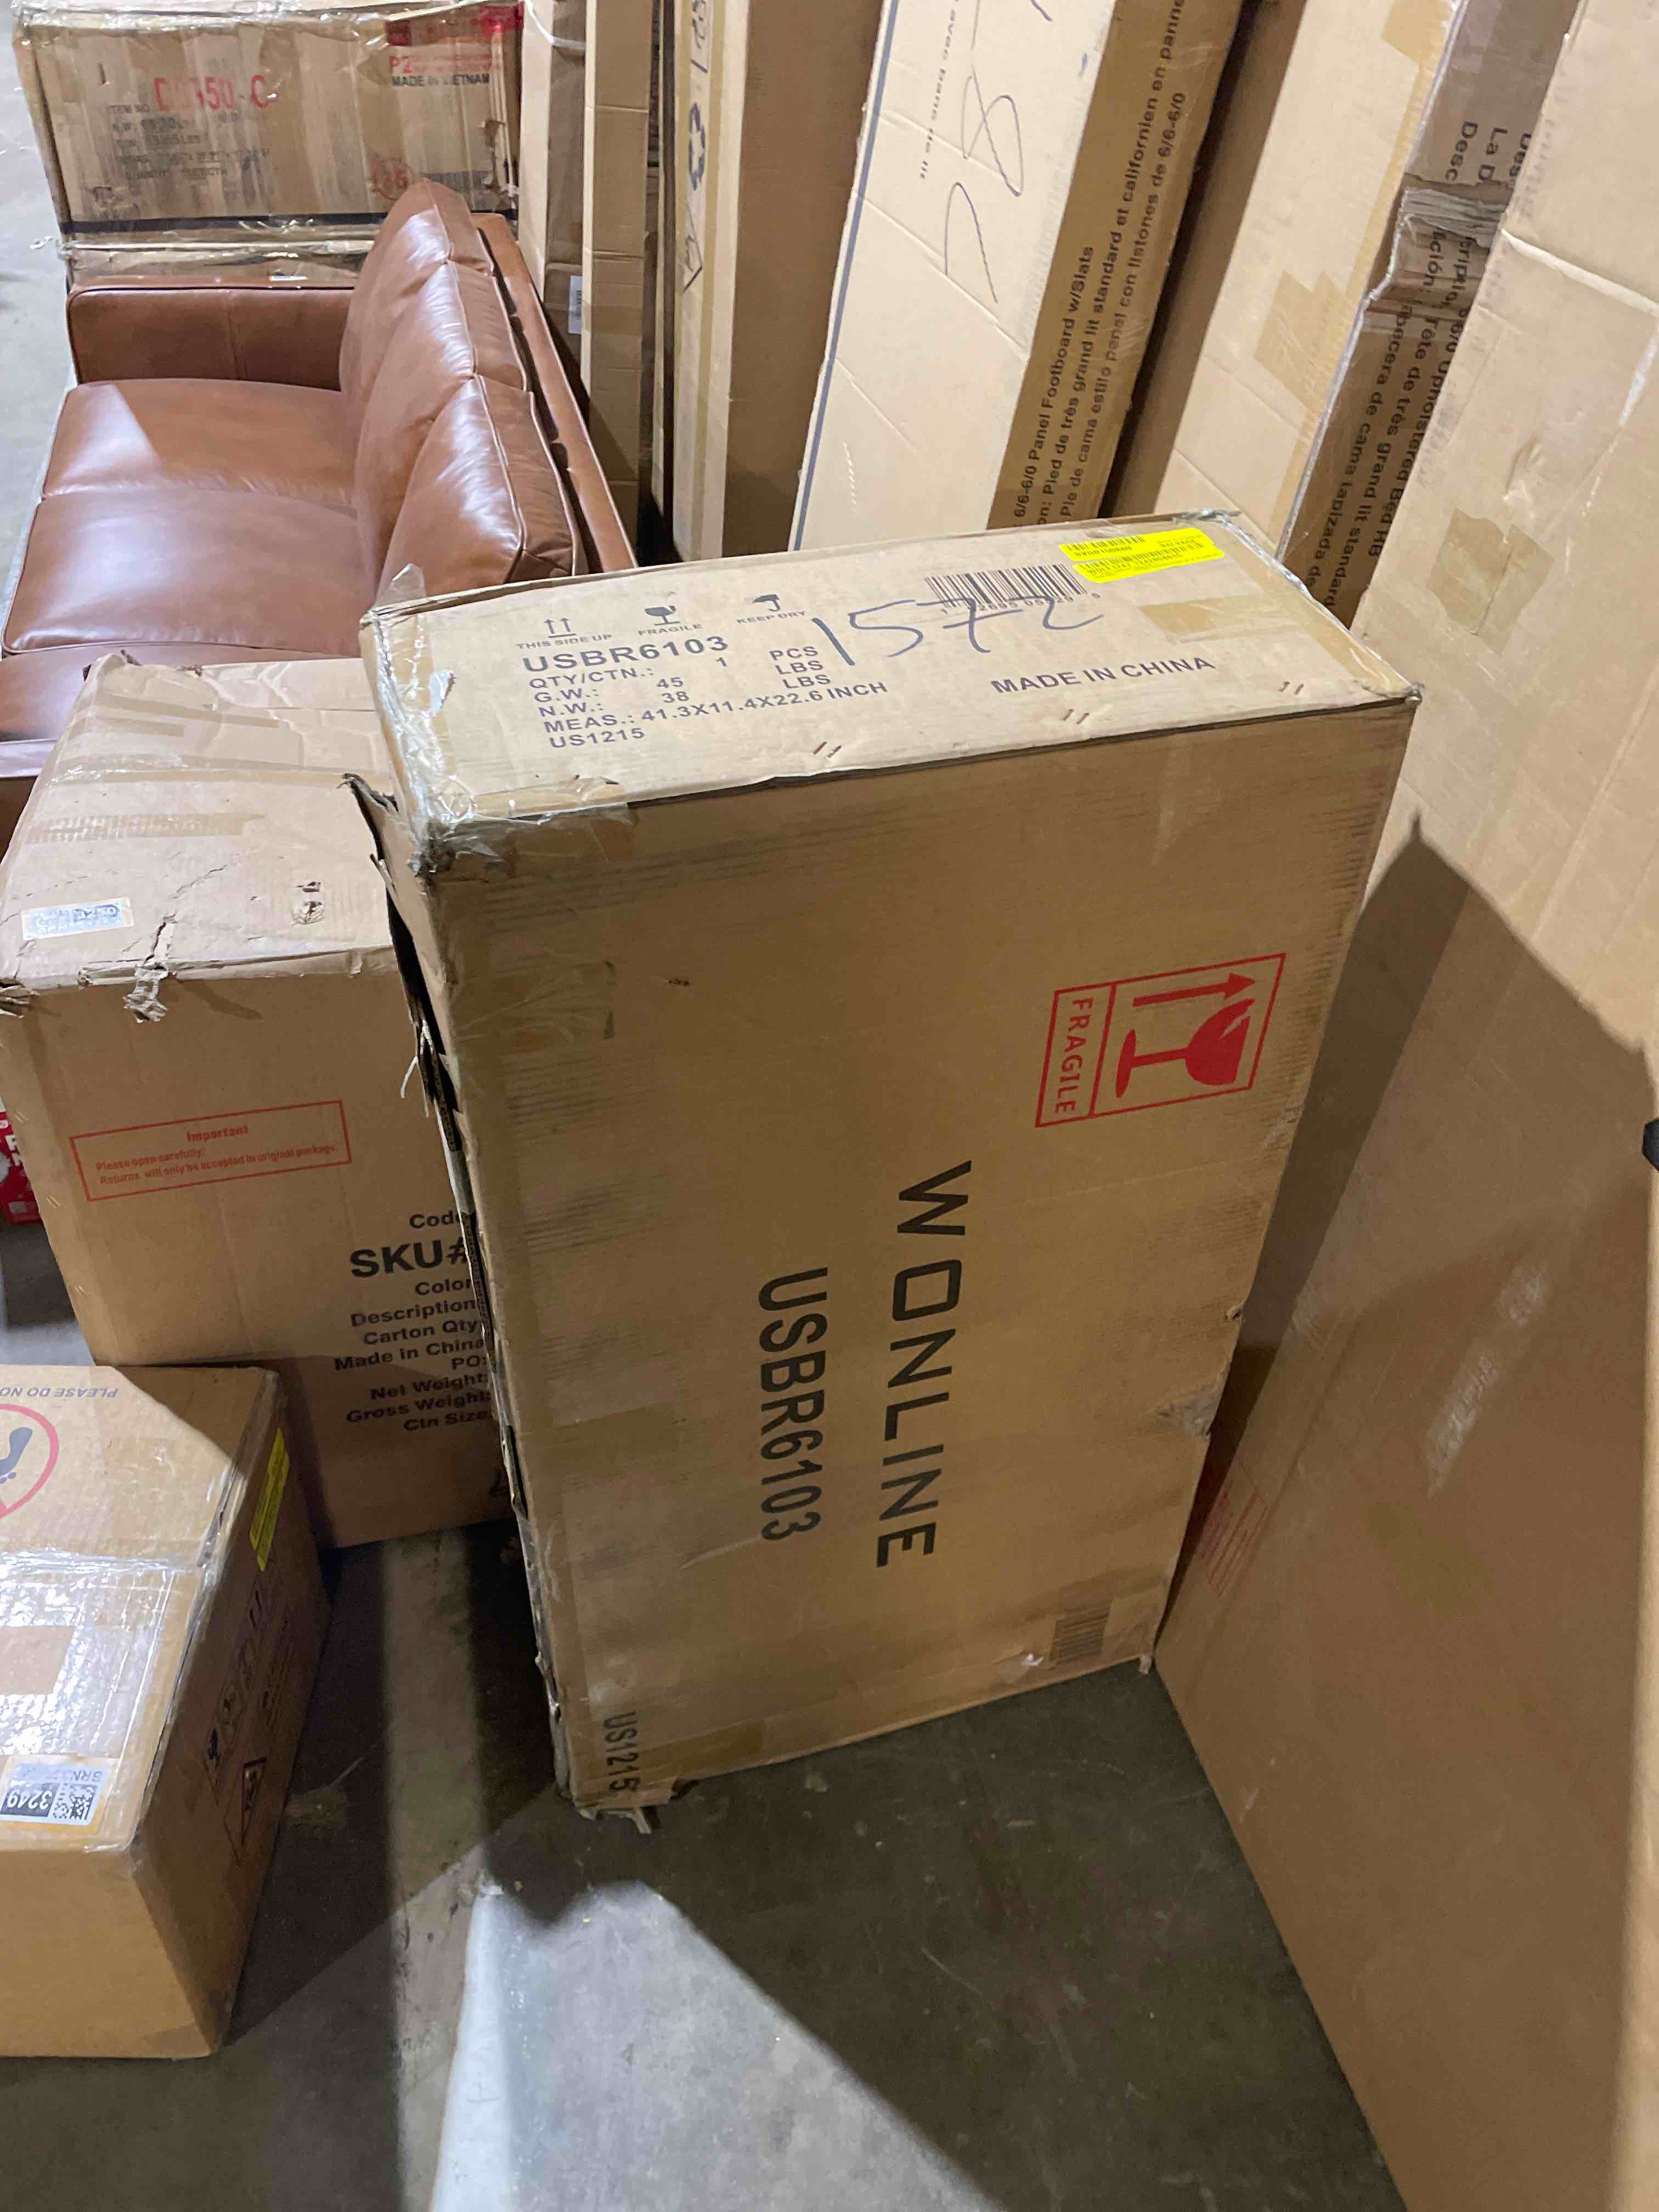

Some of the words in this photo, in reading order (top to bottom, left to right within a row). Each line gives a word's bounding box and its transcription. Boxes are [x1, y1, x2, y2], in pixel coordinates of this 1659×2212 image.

[392, 75, 424, 86] MADE
[443, 74, 490, 86] VETNAM
[1153, 66, 1165, 91] en
[1159, 92, 1187, 159] 6/6-6/0
[1124, 98, 1158, 201] californien
[1486, 127, 1508, 156] La
[1153, 163, 1167, 187] de
[1117, 206, 1128, 227] et
[1094, 231, 1122, 313] standard
[1120, 274, 1138, 307] con
[1087, 319, 1101, 337] lit
[1073, 340, 1094, 392] grand
[1402, 366, 1421, 391] de
[1014, 465, 1037, 518] 6/6-6/0
[1028, 413, 1051, 461] Panel
[1042, 318, 1075, 410] Footboard
[1068, 245, 1094, 313] w/Slats
[1091, 366, 1111, 414] estilo
[1061, 398, 1080, 431] très
[1366, 391, 1383, 417] de
[1387, 397, 1412, 437] très
[1054, 433, 1069, 455] de
[1079, 419, 1098, 463] cama
[1345, 424, 1372, 477] cama
[1043, 459, 1063, 495] Pied
[1071, 468, 1082, 487] de
[1363, 442, 1391, 499] grand
[1353, 502, 1373, 523] lit
[1324, 526, 1362, 607] standard
[638, 623, 703, 636] FRAGILE
[737, 614, 774, 624] KEEP
[778, 610, 806, 619] DRY
[516, 641, 551, 649] THIS
[555, 636, 589, 646] SIDE
[592, 633, 613, 641] UP
[523, 636, 729, 672] USBR6103
[715, 657, 727, 667] 1
[769, 646, 818, 661] PCS
[534, 688, 599, 702] G.W.:
[656, 677, 684, 688] 45
[775, 660, 823, 675] LBS
[990, 672, 1081, 694] MADE
[1084, 667, 1114, 683] IN
[1120, 656, 1216, 679] CHINA
[539, 702, 604, 717] N.W.:
[661, 691, 690, 703] 38
[782, 674, 831, 689] LBS
[826, 681, 888, 699] INCH
[549, 728, 645, 748] US1215
[1053, 996, 1093, 1114] FRAGILE
[187, 1125, 249, 1142] Important
[95, 1159, 130, 1171] Please
[131, 1155, 157, 1166] open
[100, 1172, 140, 1185] Returns
[144, 1168, 163, 1178] will
[163, 1166, 185, 1176] only
[185, 1164, 199, 1172] be
[200, 1155, 245, 1168] accepted
[257, 1149, 295, 1162] original
[351, 1298, 476, 1327] Description
[364, 1324, 435, 1345] Carton
[442, 1319, 478, 1335] Qty
[334, 1351, 394, 1371] Made
[399, 1347, 419, 1361] in
[426, 1338, 484, 1356] China
[877, 1160, 972, 1568] WONLINE
[27, 1387, 51, 1398] DO
[53, 1387, 119, 1398] PLEASE
[370, 1384, 407, 1401] Net
[758, 1266, 828, 1541] USBR6103
[346, 1406, 410, 1423] Gross
[603, 1711, 641, 1793] US1215
[7, 1790, 53, 1810] 3249
